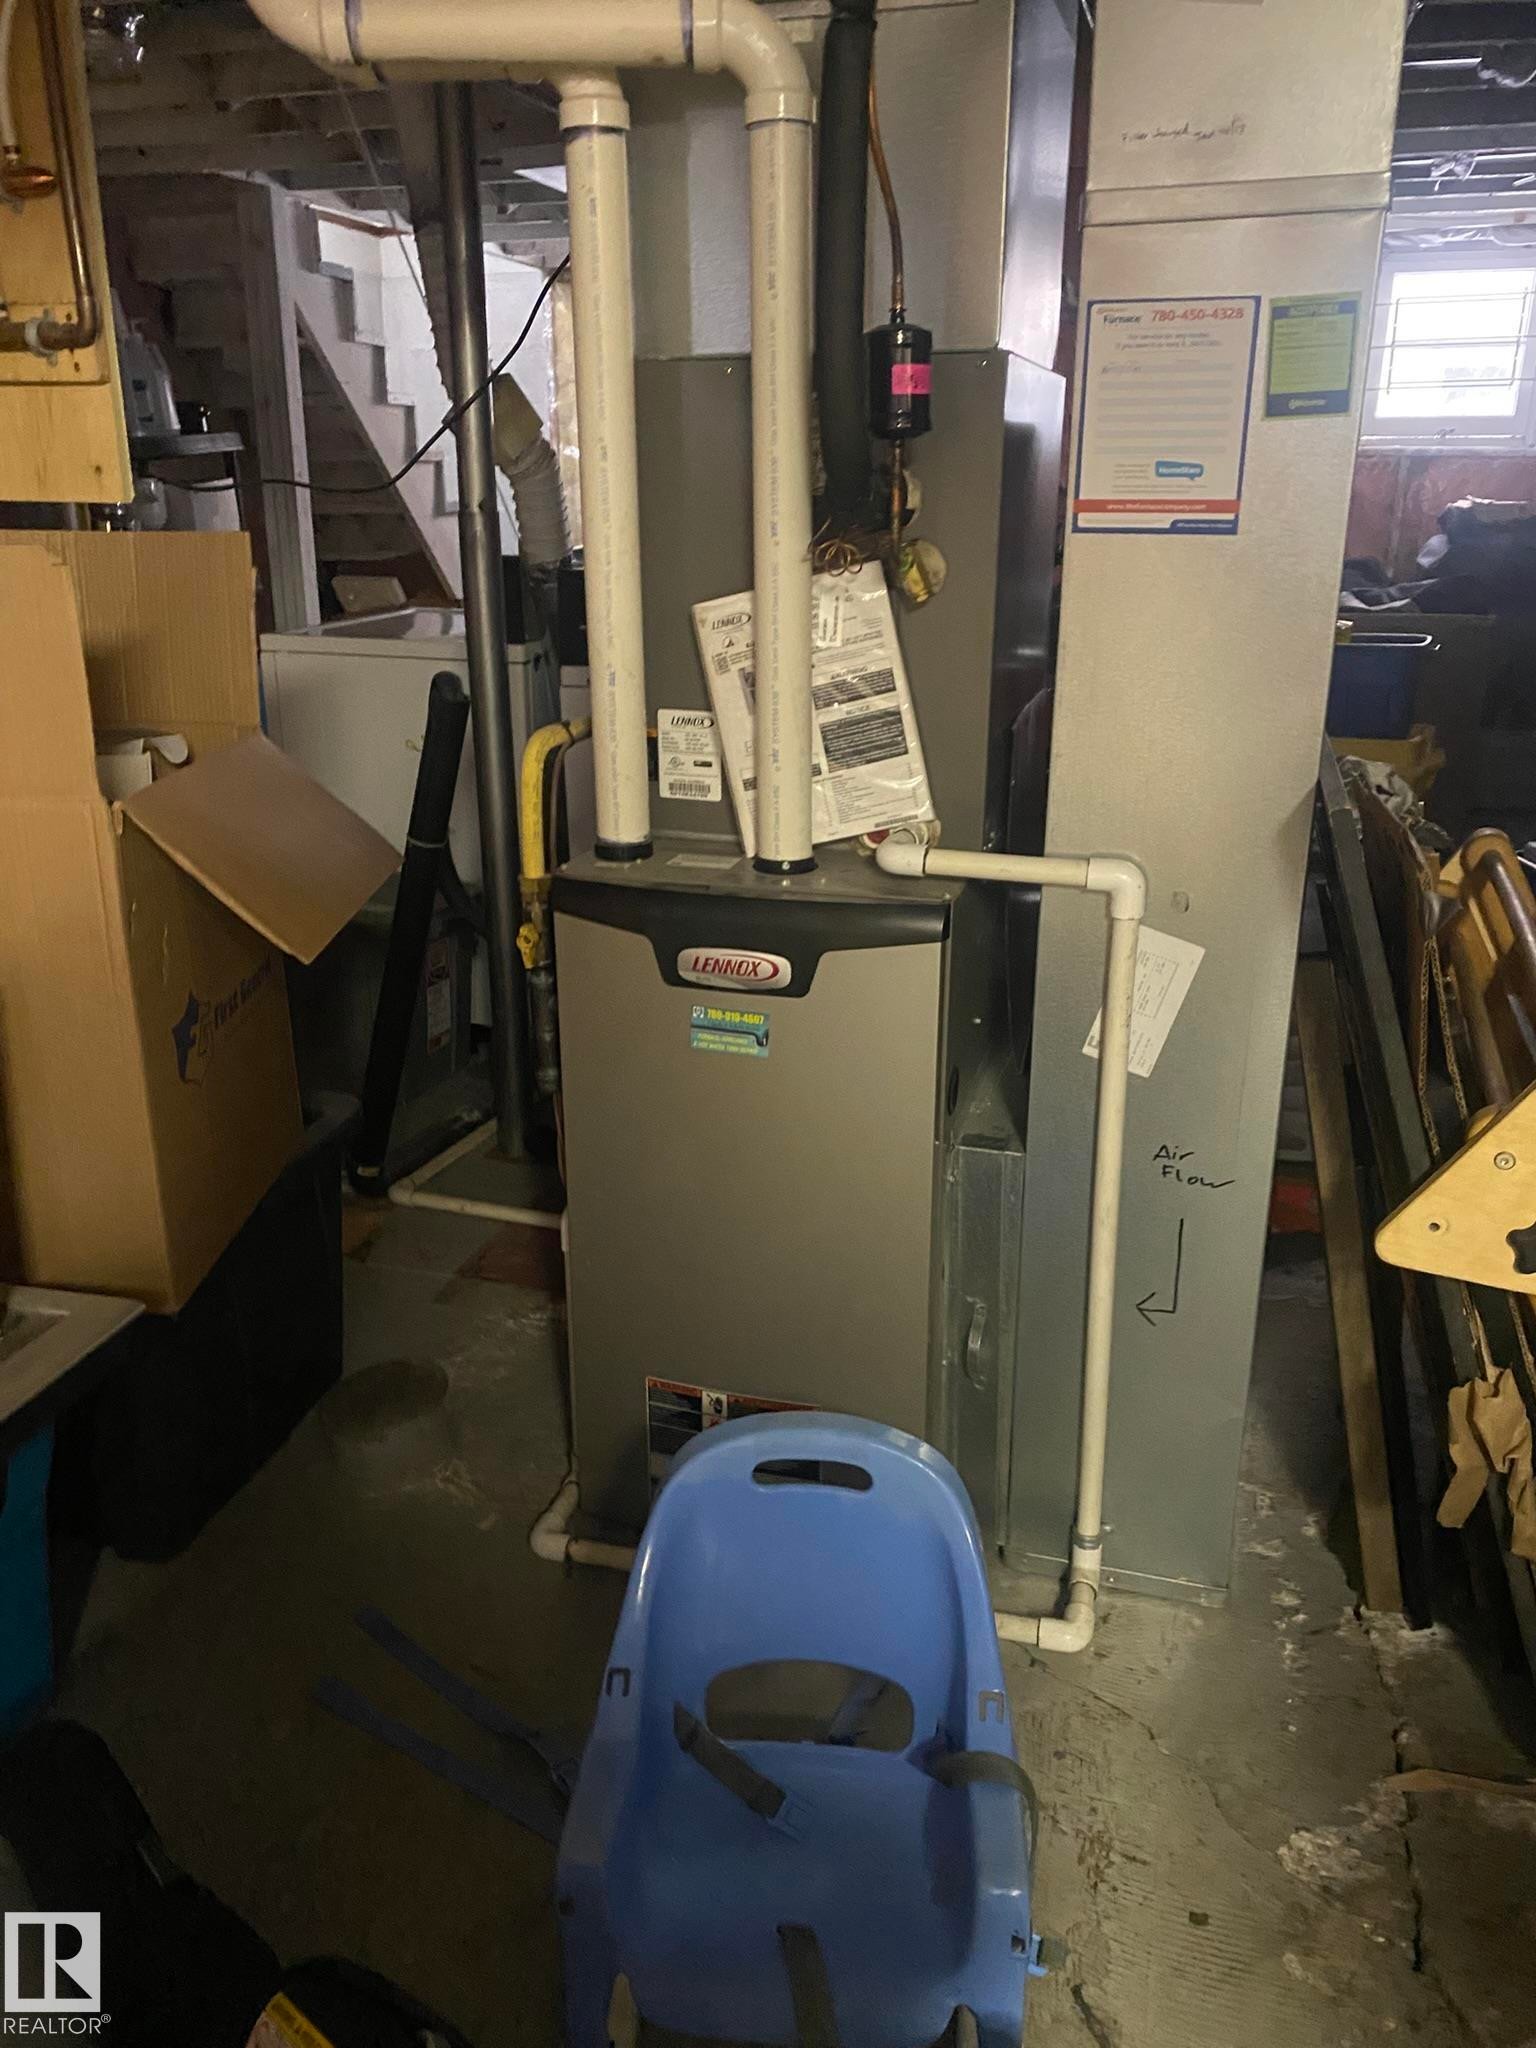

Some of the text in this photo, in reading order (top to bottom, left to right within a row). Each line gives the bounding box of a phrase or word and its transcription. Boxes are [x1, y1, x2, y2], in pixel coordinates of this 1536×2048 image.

[1151, 307, 1246, 323] 780-450-4328
[692, 956, 762, 978] LENNOX
[1153, 1143, 1194, 1162] Air
[1160, 1163, 1236, 1188] Flow
